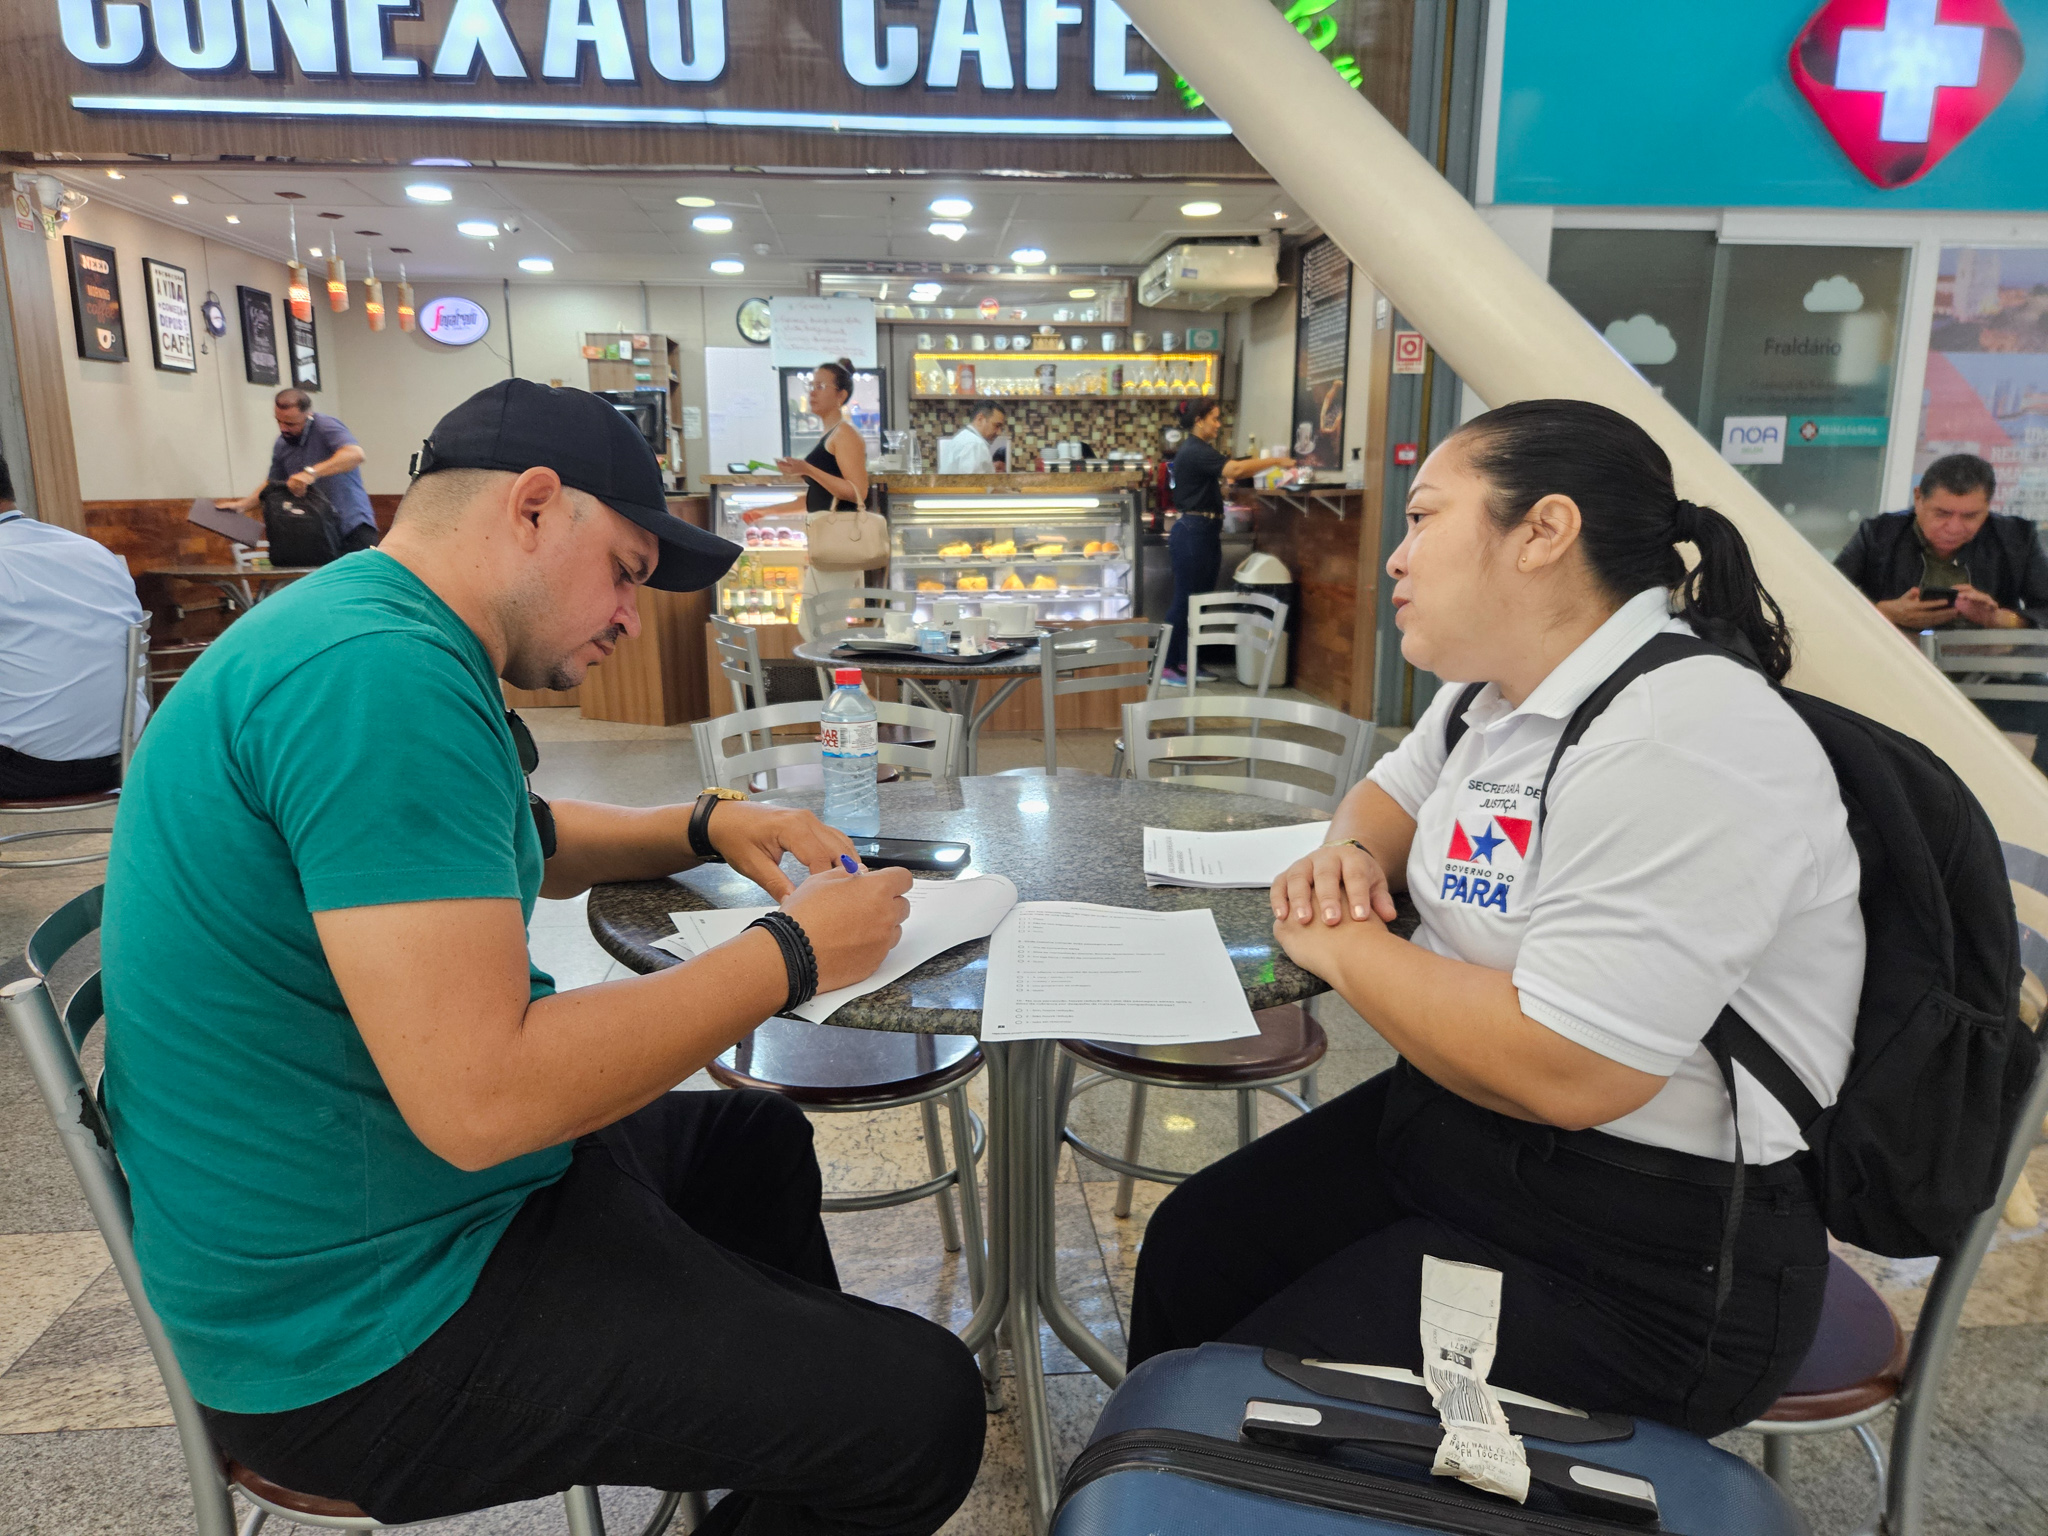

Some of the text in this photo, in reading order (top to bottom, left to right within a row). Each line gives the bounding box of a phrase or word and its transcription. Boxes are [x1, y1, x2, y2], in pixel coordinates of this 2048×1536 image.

[80, 254, 109, 274] NEED
[163, 279, 185, 303] VIDA
[160, 314, 183, 331] DEPOIS
[162, 332, 192, 357] CAFÉ
[1763, 336, 1842, 357] Fraldário
[1468, 779, 1542, 800] SECRETARIA DE
[1479, 798, 1517, 814] JUSTIÇA
[1444, 863, 1515, 883] GOVERNO DO
